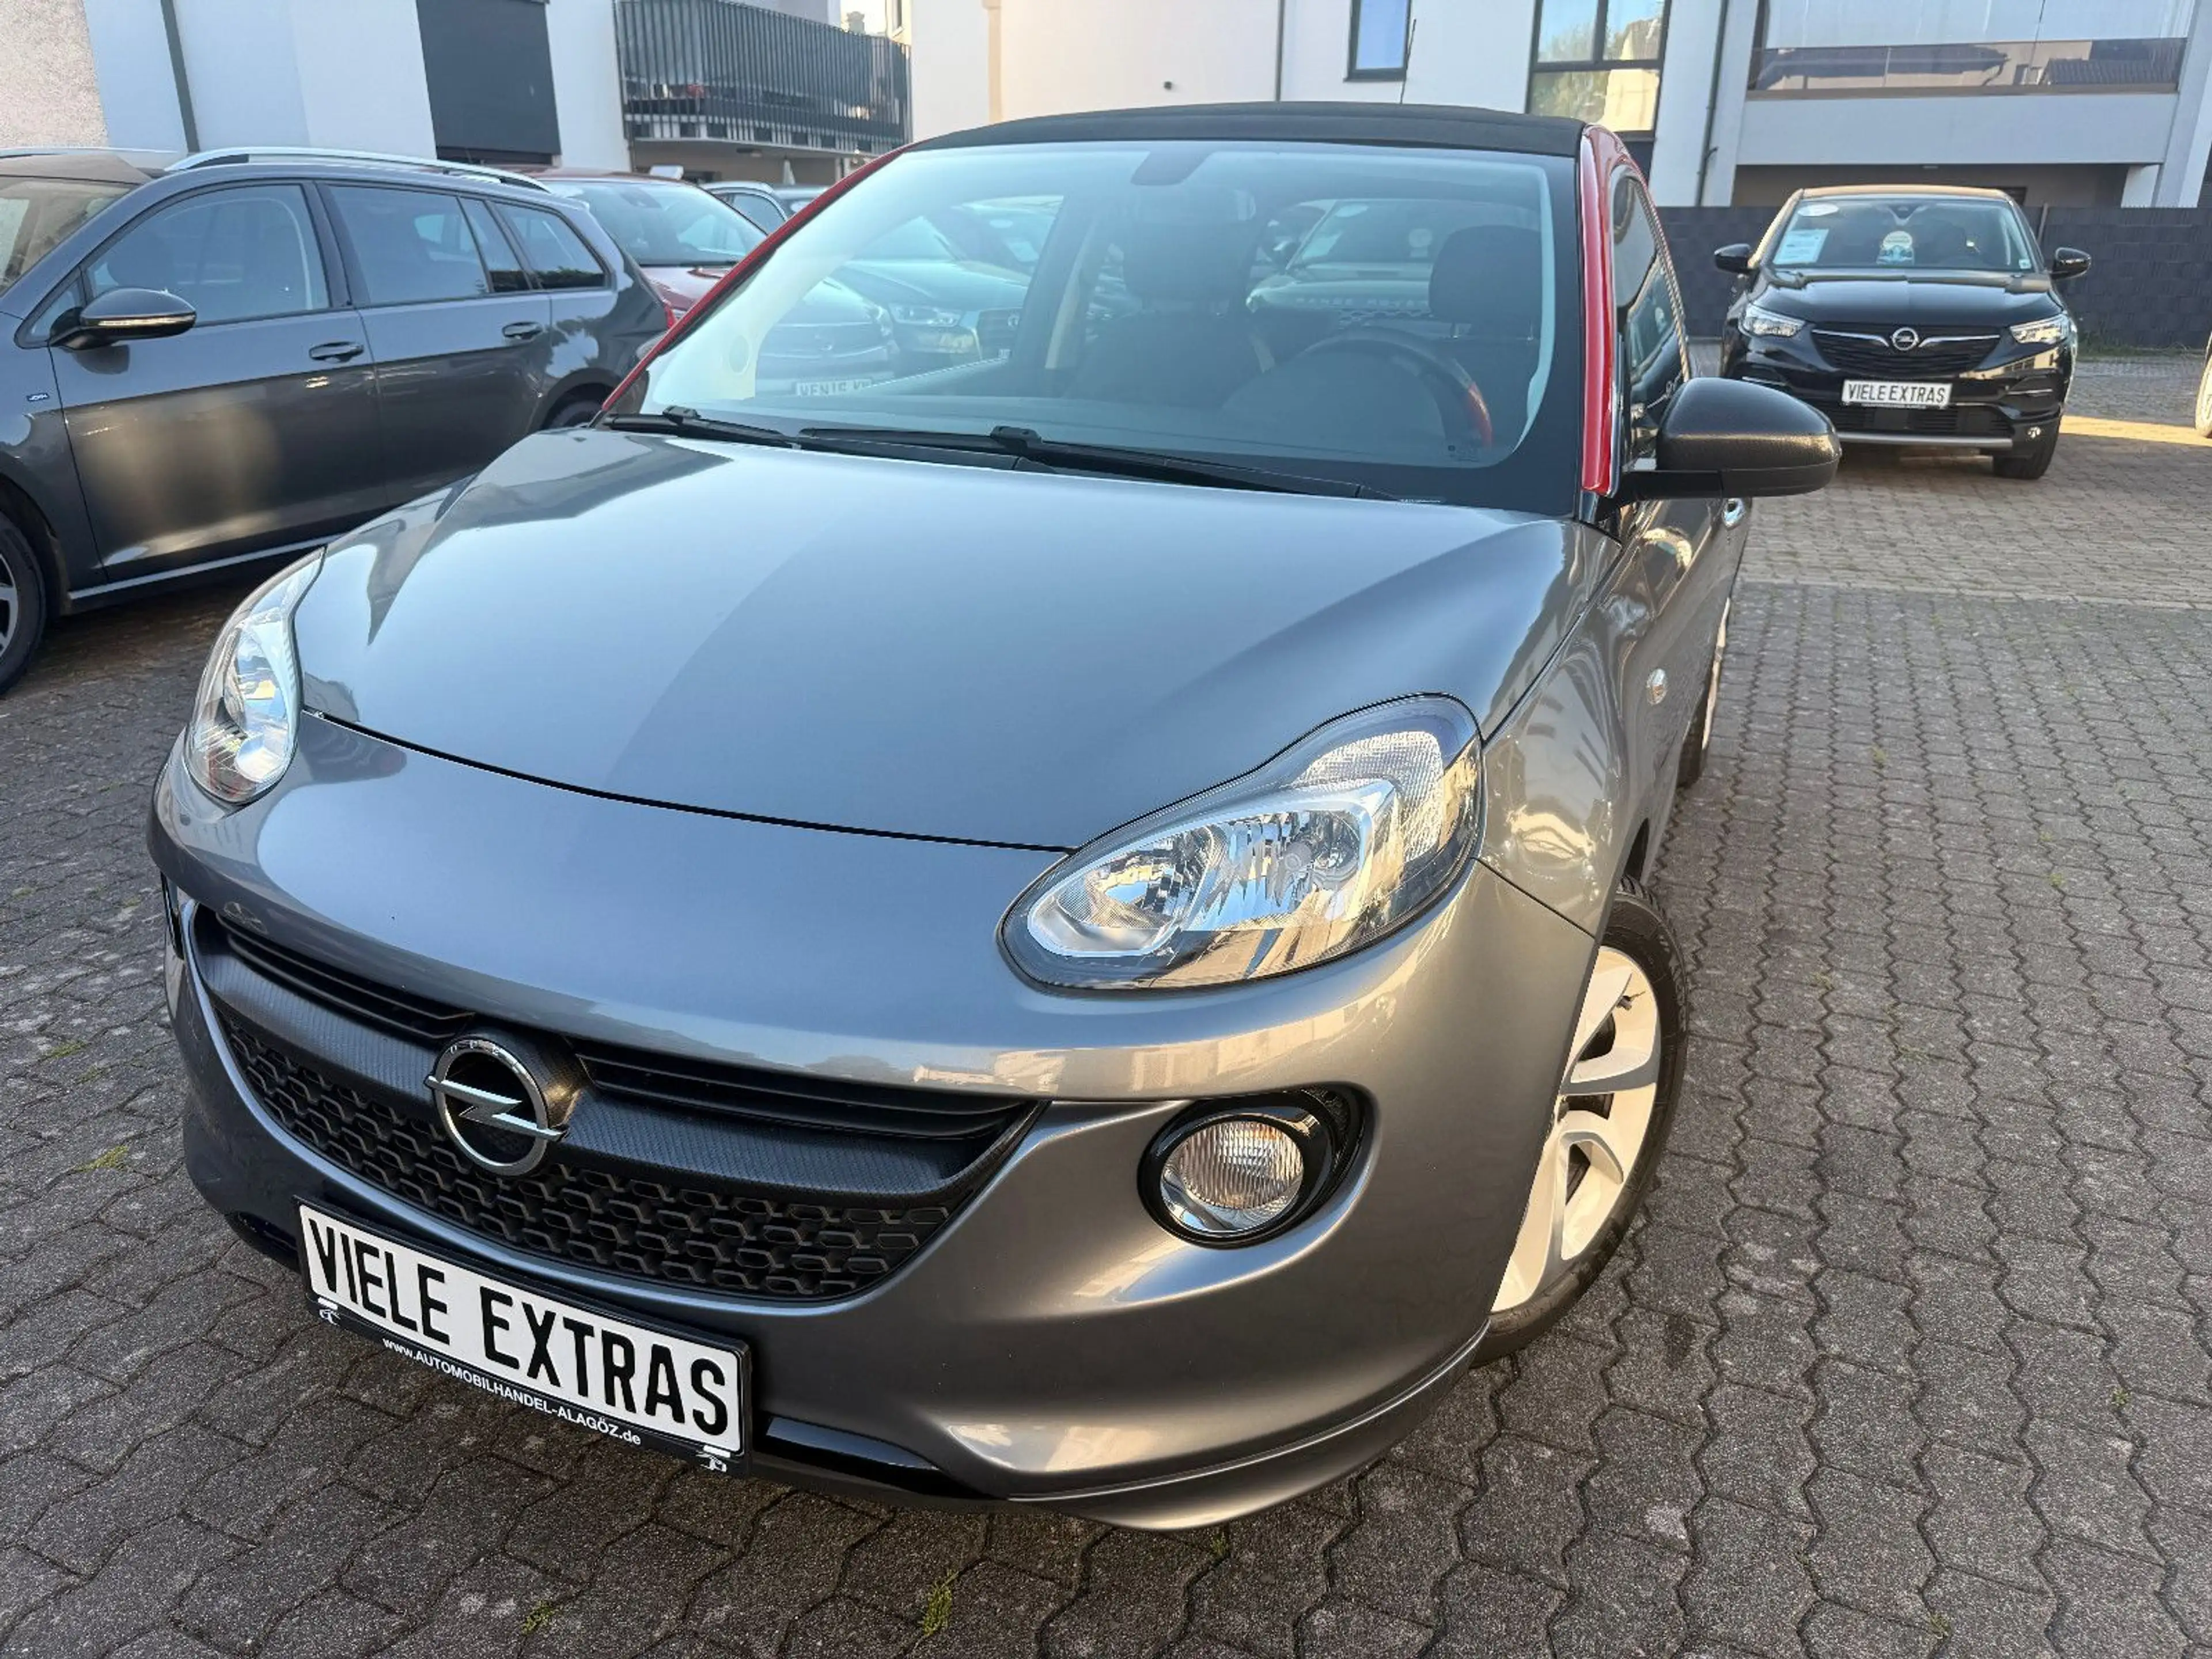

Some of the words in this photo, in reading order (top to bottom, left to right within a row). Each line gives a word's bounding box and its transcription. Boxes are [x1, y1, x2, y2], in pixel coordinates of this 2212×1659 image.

[1849, 384, 1887, 401] VIELE
[1889, 385, 1945, 403] EXTRAS
[309, 1219, 450, 1345] VIELE
[480, 1286, 728, 1435] EXTRAS
[382, 1338, 642, 1445] www.AUTOMOBILHANDEL-ALAGÖZ.de
